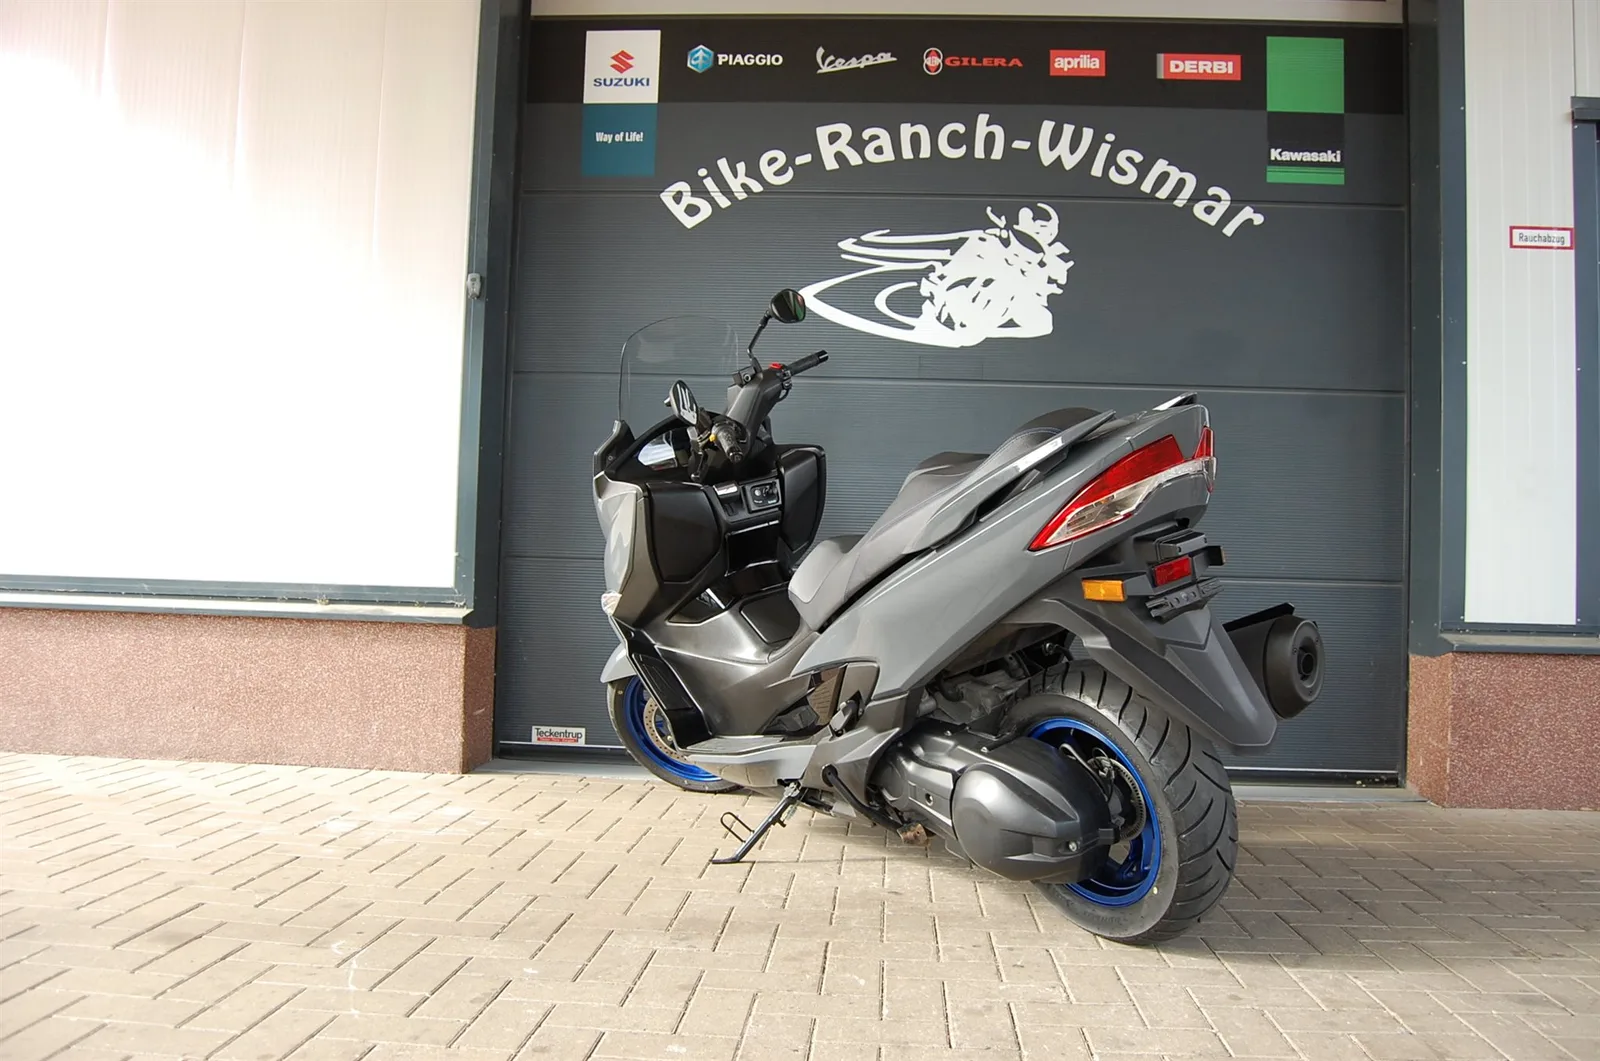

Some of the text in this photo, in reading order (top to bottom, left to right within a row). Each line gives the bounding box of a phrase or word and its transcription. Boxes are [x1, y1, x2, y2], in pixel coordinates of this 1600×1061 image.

[717, 53, 784, 66] PIAGGIO
[815, 46, 898, 75] Vespa
[945, 56, 1024, 67] GILERA
[1054, 54, 1100, 71] aprilia
[1169, 60, 1234, 74] DERBI
[593, 77, 650, 87] SUZUKI
[595, 131, 644, 144] Way of Life!
[1270, 148, 1341, 163] Kawasaki
[660, 113, 1265, 238] Bike-Ranch-Wismar
[1518, 232, 1565, 246] Rauchabzug
[534, 727, 583, 743] Teckentrup
